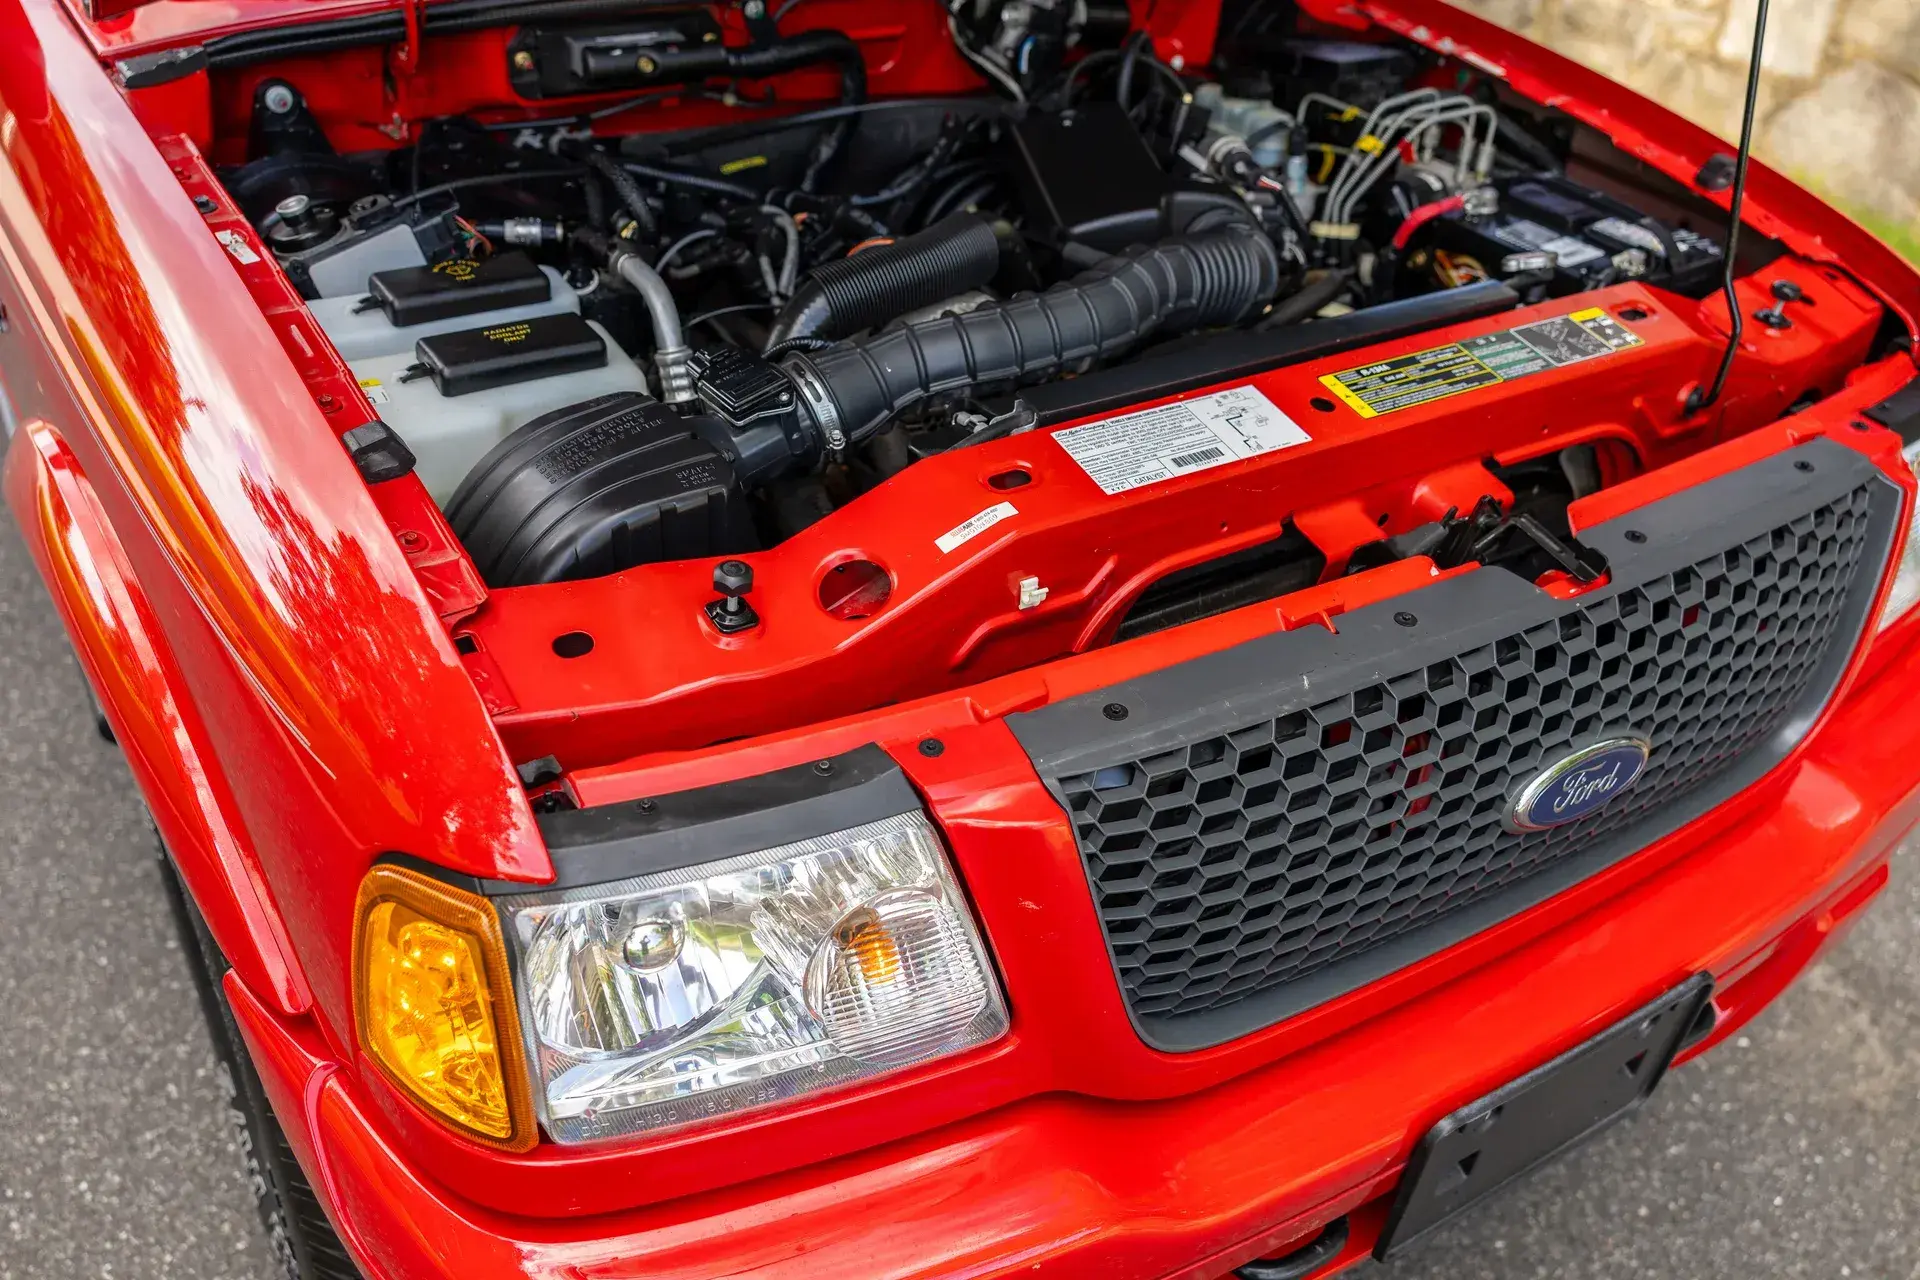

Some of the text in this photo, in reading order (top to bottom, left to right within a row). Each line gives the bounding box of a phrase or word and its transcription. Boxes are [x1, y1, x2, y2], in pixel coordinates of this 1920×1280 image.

[483, 324, 529, 336] RADIATOR
[490, 328, 531, 341] COOLANT
[503, 335, 526, 343] ONLY
[608, 417, 646, 435] TOOLS
[1132, 471, 1168, 484] CATALYST
[1554, 760, 1621, 813] Ford
[582, 1122, 610, 1138] DOT
